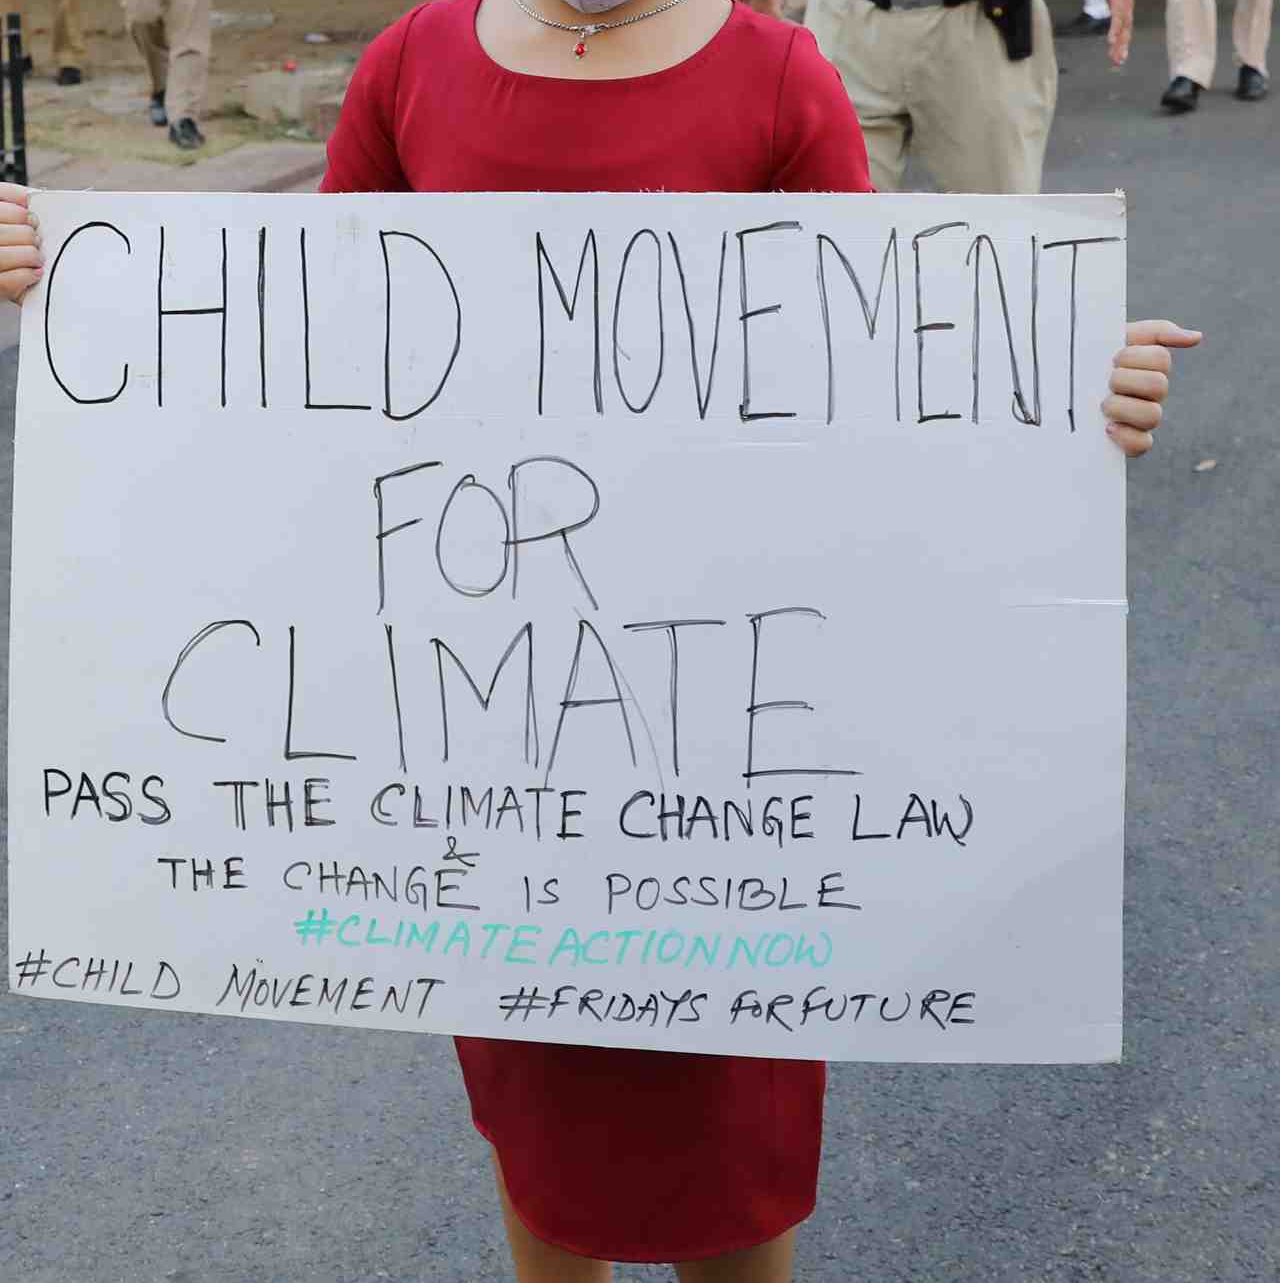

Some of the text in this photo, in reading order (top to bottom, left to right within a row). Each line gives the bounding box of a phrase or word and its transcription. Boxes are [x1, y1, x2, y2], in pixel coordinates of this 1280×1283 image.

[45, 221, 1119, 432] CHILD MOVEMENT
[373, 456, 600, 614] FOR
[161, 606, 862, 780] CLIMATE
[43, 768, 974, 848] PASS THE CLIMATE CHANGE LAW
[157, 856, 863, 912] THE CHANGE IS POSSIBLE
[442, 835, 481, 867] &
[15, 948, 181, 1000] #CHILD
[216, 963, 446, 1018] MOVEMENT
[498, 984, 708, 1030] #FRIDAYS
